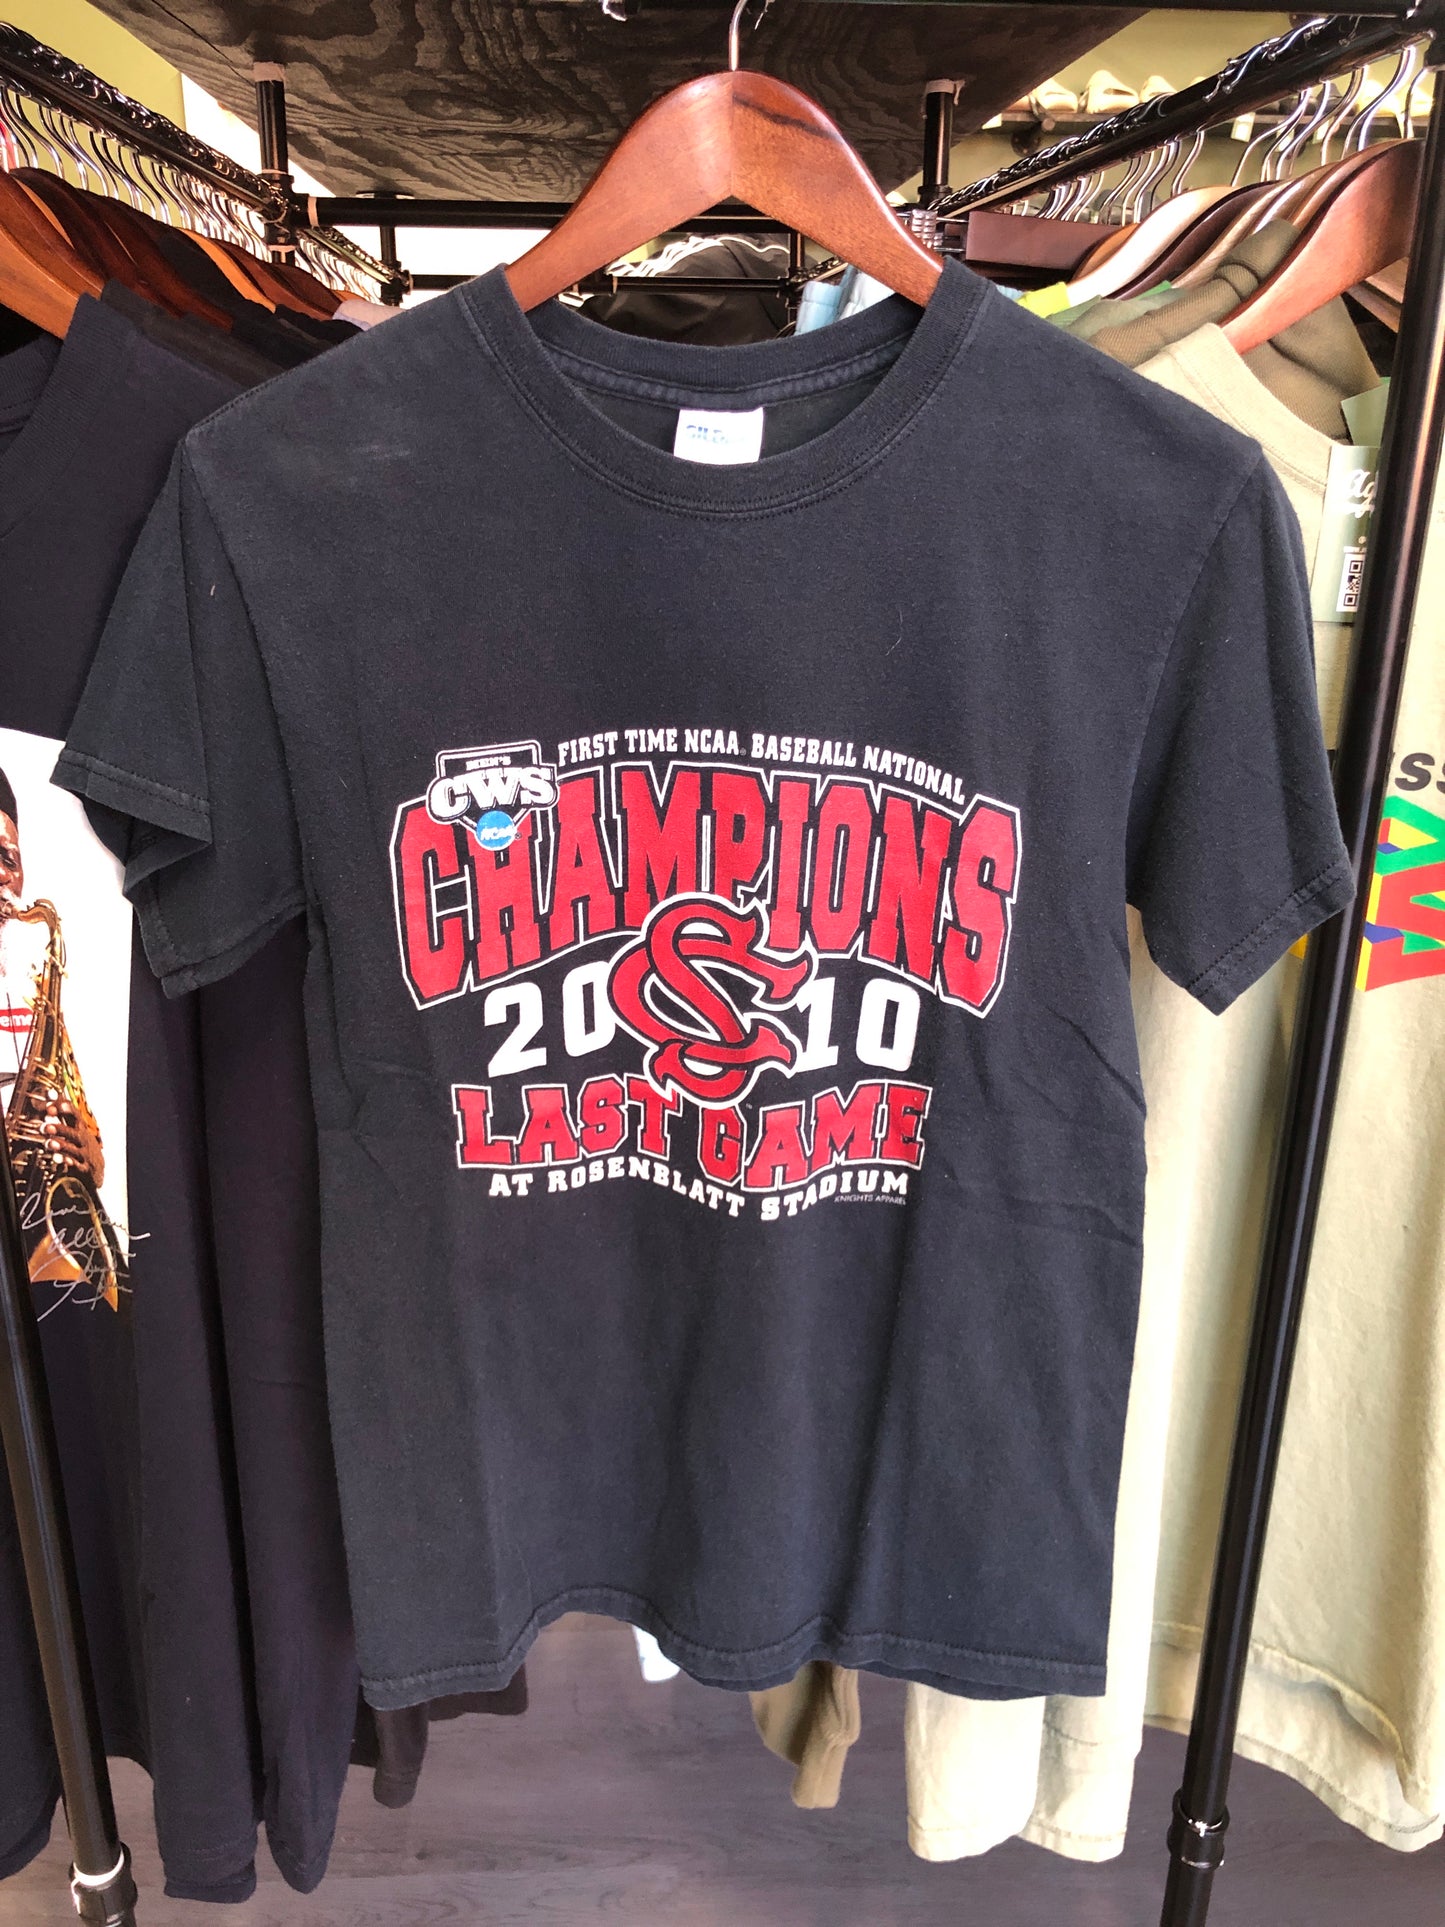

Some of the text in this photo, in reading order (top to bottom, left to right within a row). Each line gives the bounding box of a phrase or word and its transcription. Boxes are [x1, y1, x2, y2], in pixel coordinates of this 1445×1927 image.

[430, 765, 555, 821] CWS
[557, 731, 618, 767] FIRST
[624, 728, 678, 753] TIME
[750, 733, 857, 768] BASEBALL
[862, 745, 966, 805] NATIONAL
[389, 761, 1023, 1019] CHAMPIONS
[451, 1075, 934, 1194] LAST GAME
[488, 1154, 909, 1222] AT ROSENBLATT STADIUM
[874, 1195, 907, 1207] APPAREL
